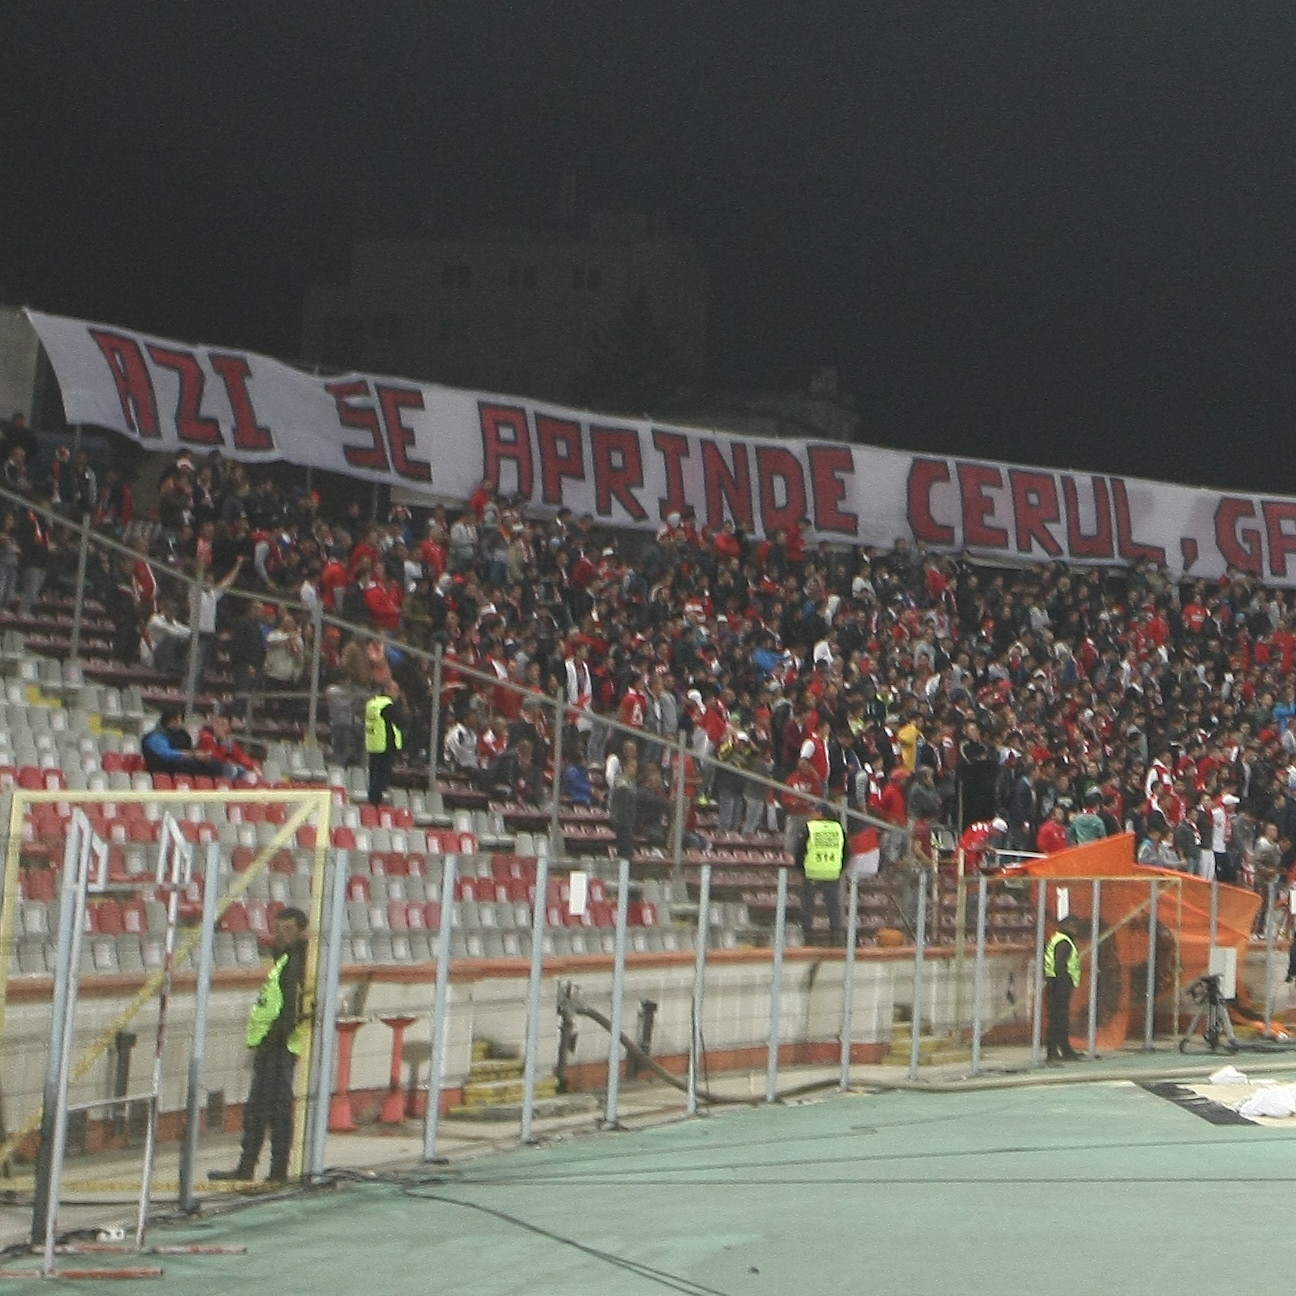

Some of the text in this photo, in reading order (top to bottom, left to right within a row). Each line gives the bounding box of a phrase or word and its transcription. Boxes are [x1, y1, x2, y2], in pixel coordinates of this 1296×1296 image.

[88, 327, 274, 451] AZI
[325, 379, 433, 482] SE
[477, 401, 860, 536] APRINDE
